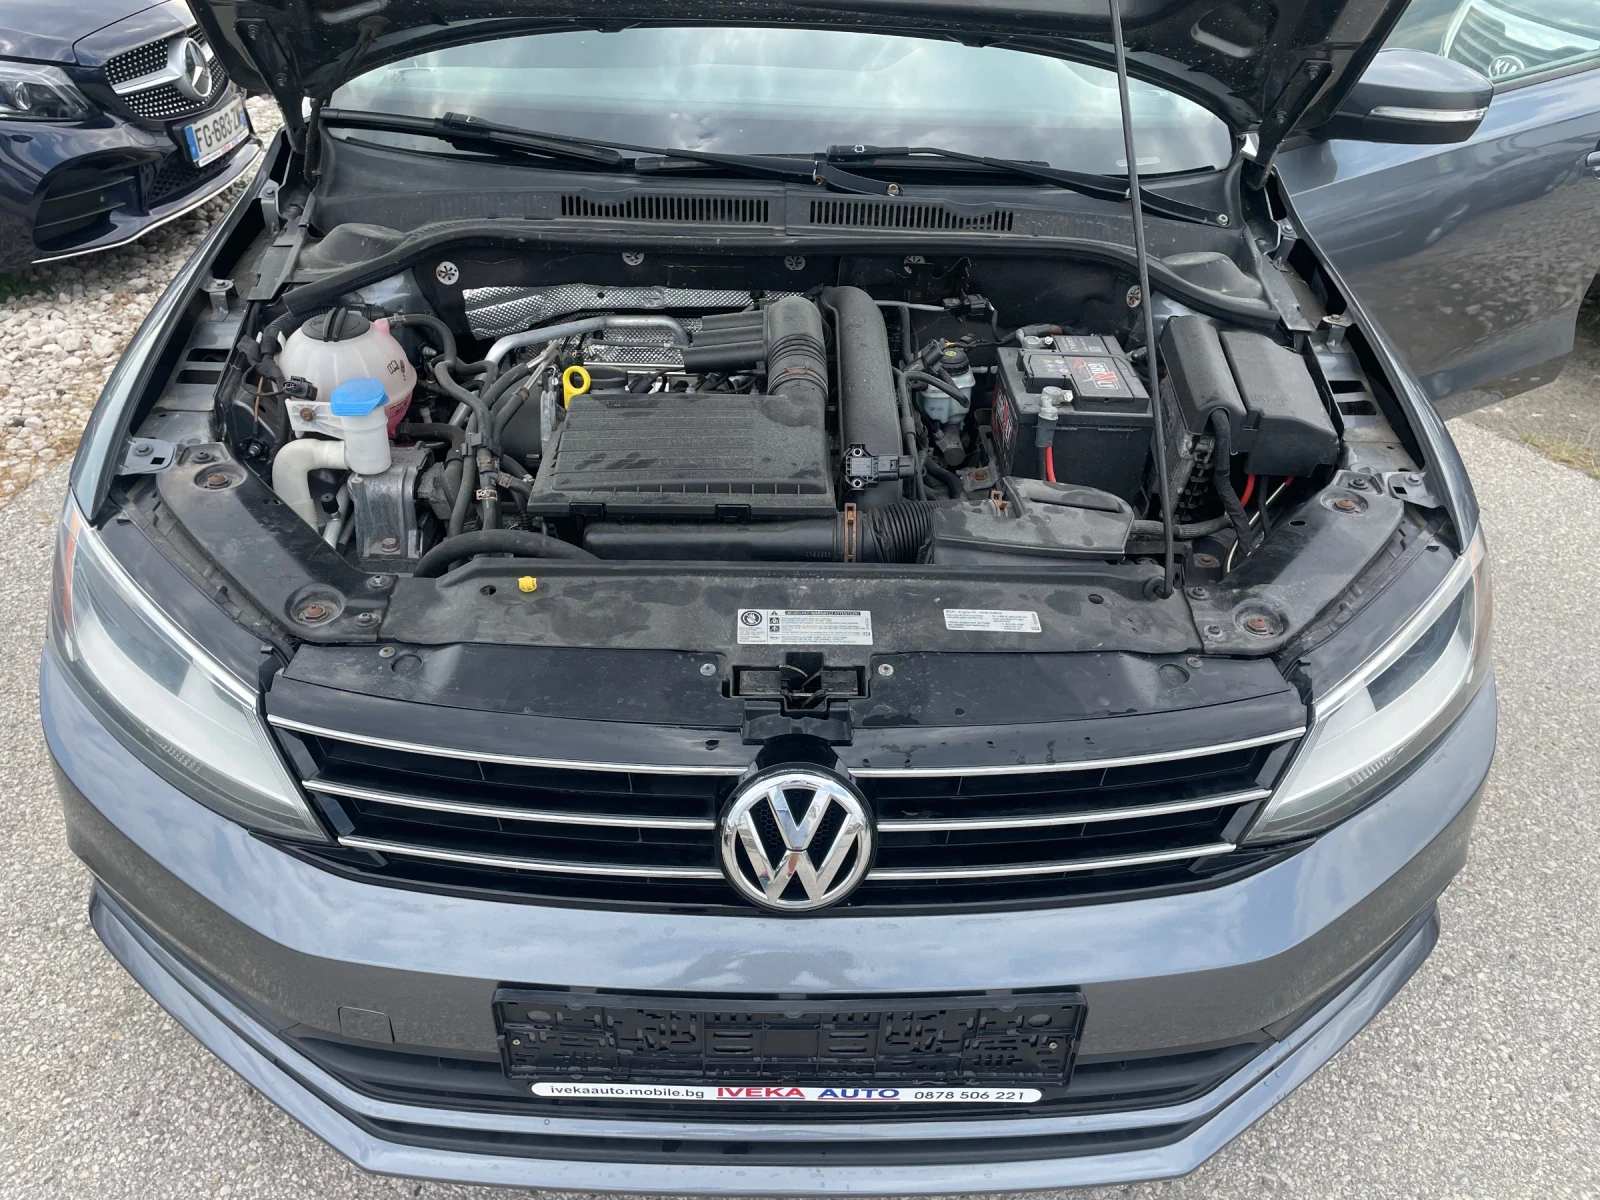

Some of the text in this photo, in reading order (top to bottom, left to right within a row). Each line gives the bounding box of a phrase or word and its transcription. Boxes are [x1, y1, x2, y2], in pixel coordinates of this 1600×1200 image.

[550, 1085, 1024, 1100] ivekaauto.mobile.bg IVEKA AUTO 0878 506 221
